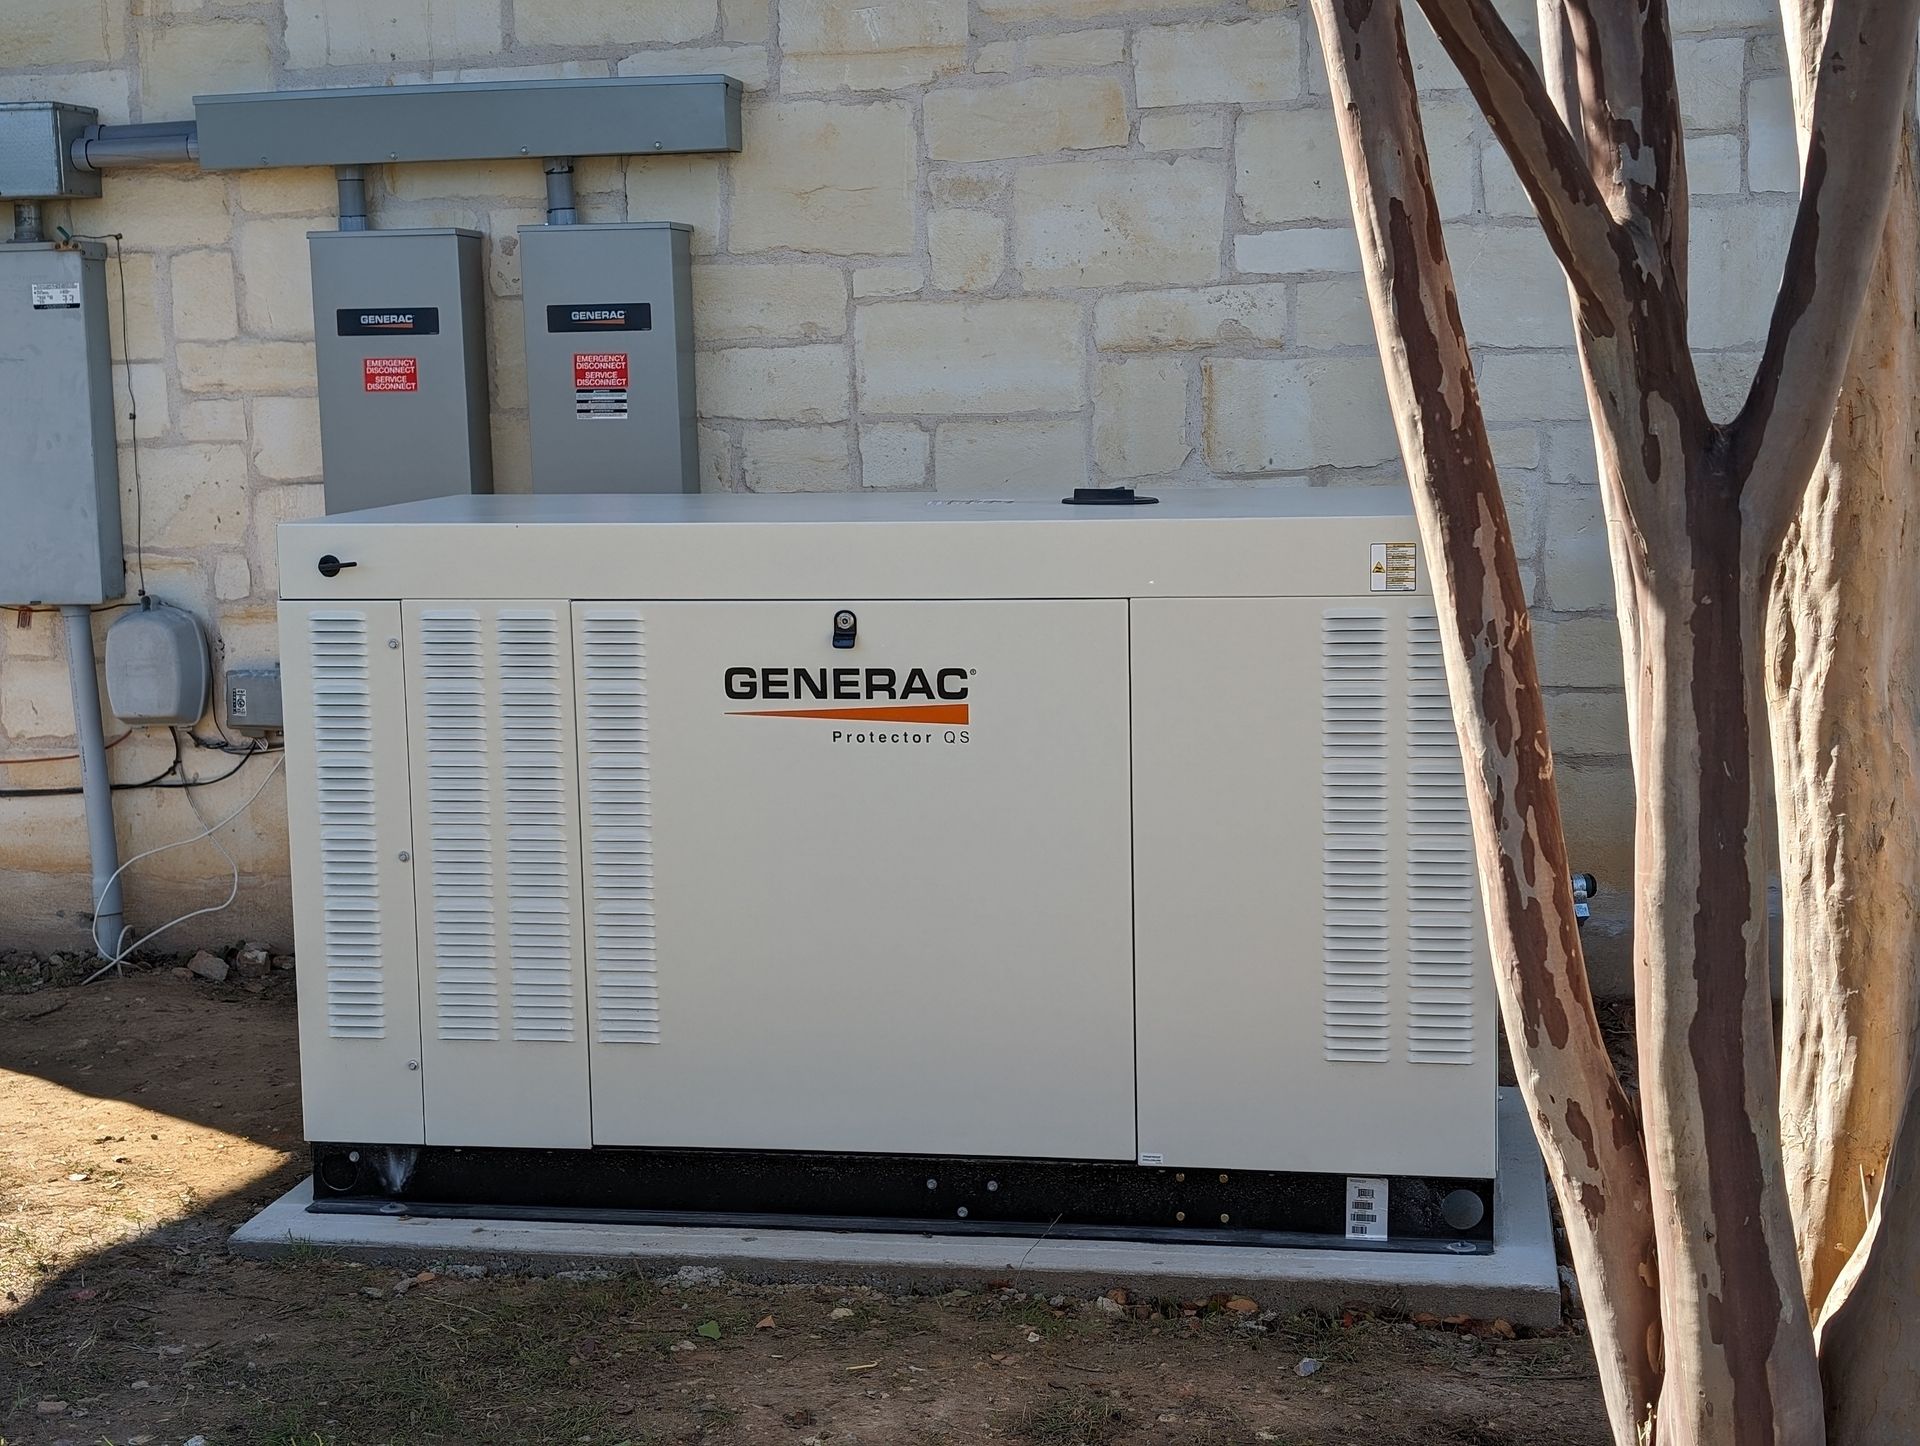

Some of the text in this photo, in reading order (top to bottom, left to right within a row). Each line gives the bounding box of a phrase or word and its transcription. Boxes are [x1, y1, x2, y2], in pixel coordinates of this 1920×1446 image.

[360, 315, 413, 324] GENERAC
[571, 311, 625, 320] GENERAC
[577, 378, 627, 386] DISCONNECT
[832, 731, 970, 744] Protector QS
